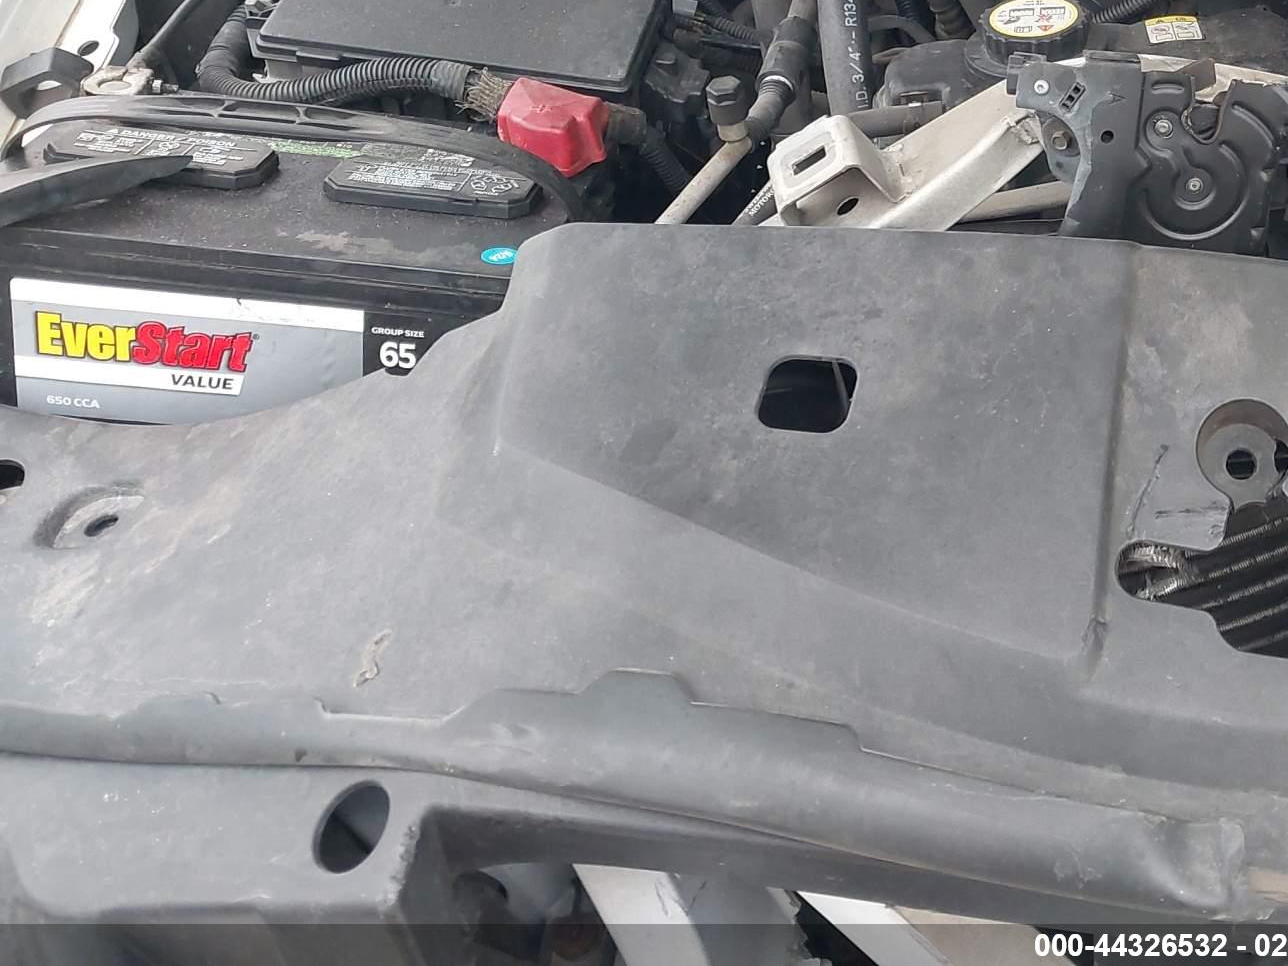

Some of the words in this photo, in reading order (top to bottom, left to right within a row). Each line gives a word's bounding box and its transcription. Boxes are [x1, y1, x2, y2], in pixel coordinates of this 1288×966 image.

[371, 326, 399, 337] GROUP
[399, 328, 425, 338] SIZE
[379, 341, 417, 369] 65
[170, 372, 234, 392] VALUE
[46, 395, 72, 408] 650
[73, 396, 100, 410] CCA
